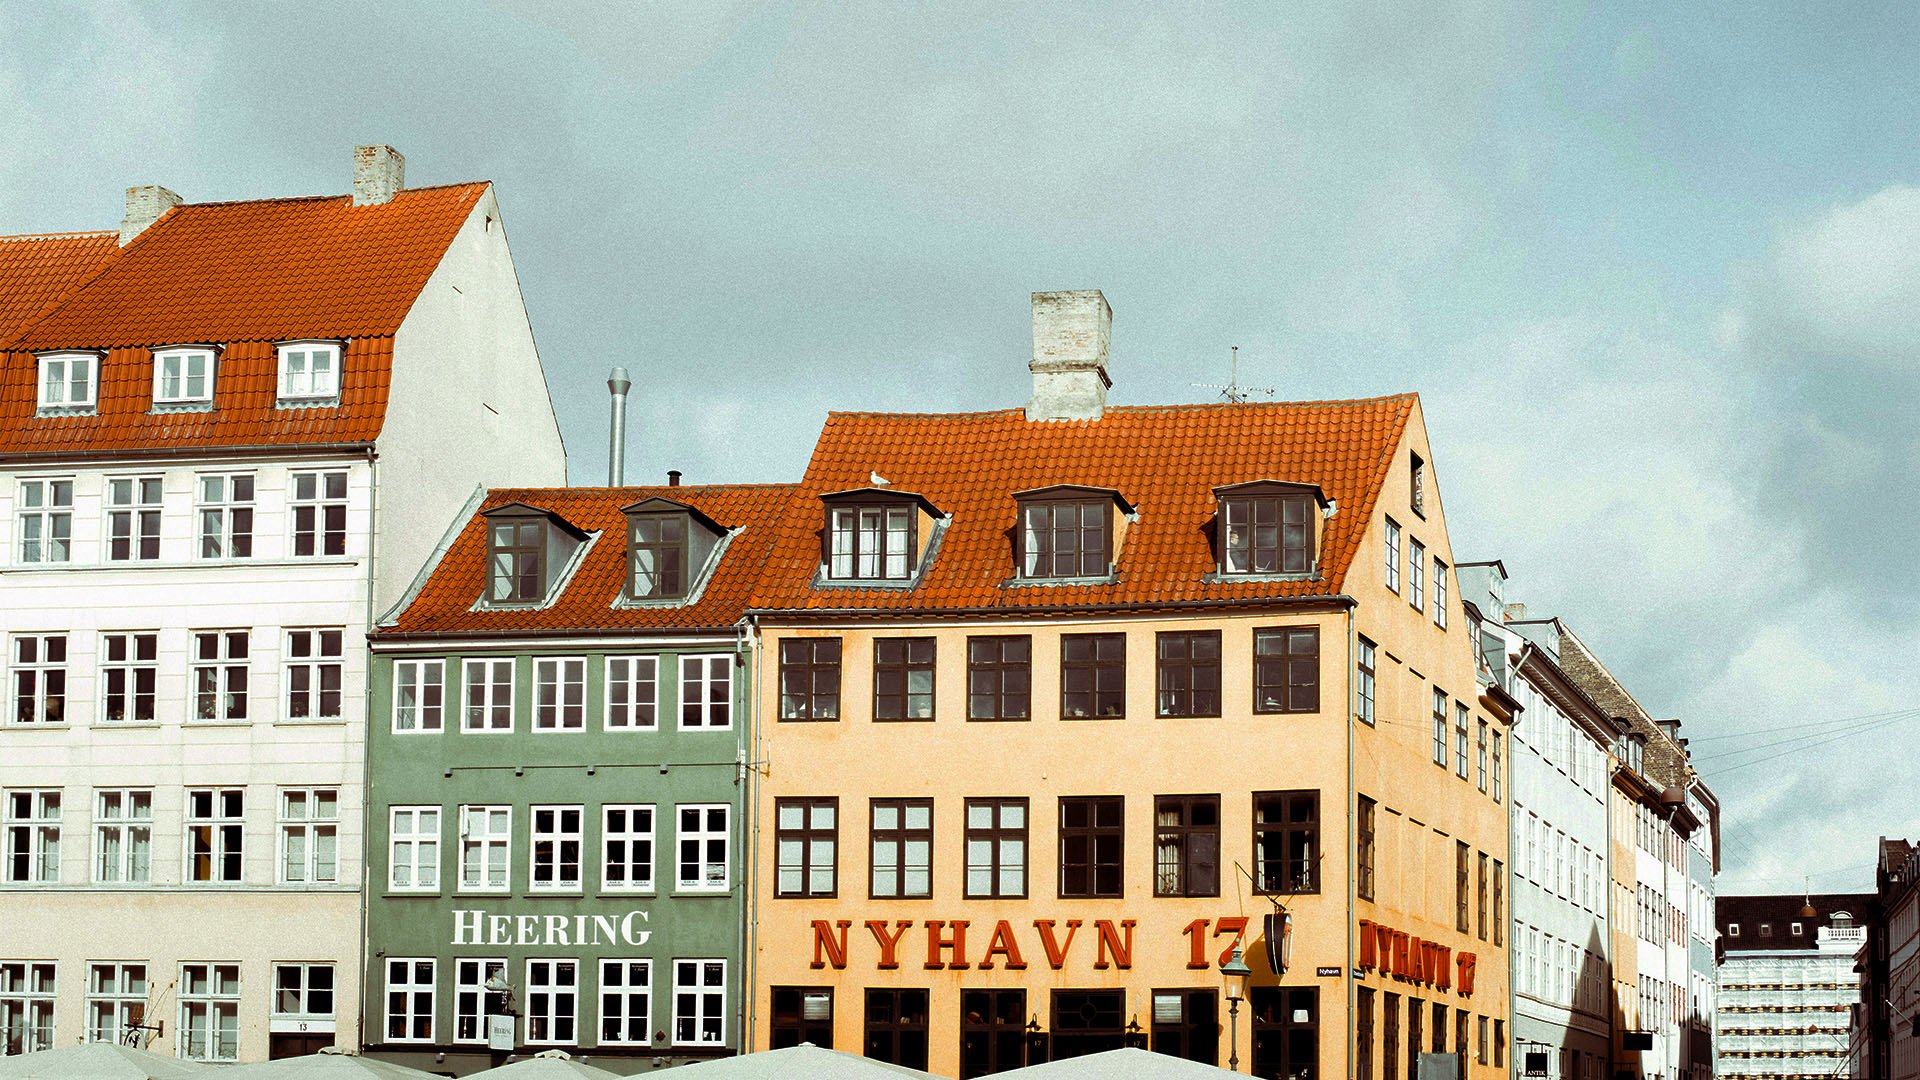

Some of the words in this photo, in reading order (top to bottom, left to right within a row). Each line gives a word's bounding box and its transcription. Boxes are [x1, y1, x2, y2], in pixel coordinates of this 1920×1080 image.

[450, 910, 652, 946] HEERING
[810, 919, 1138, 969] NYHAVN
[1182, 916, 1249, 970] 17
[1319, 968, 1339, 976] Nyhavn
[1359, 919, 1451, 990] NYHAVN
[299, 1023, 308, 1031] 13
